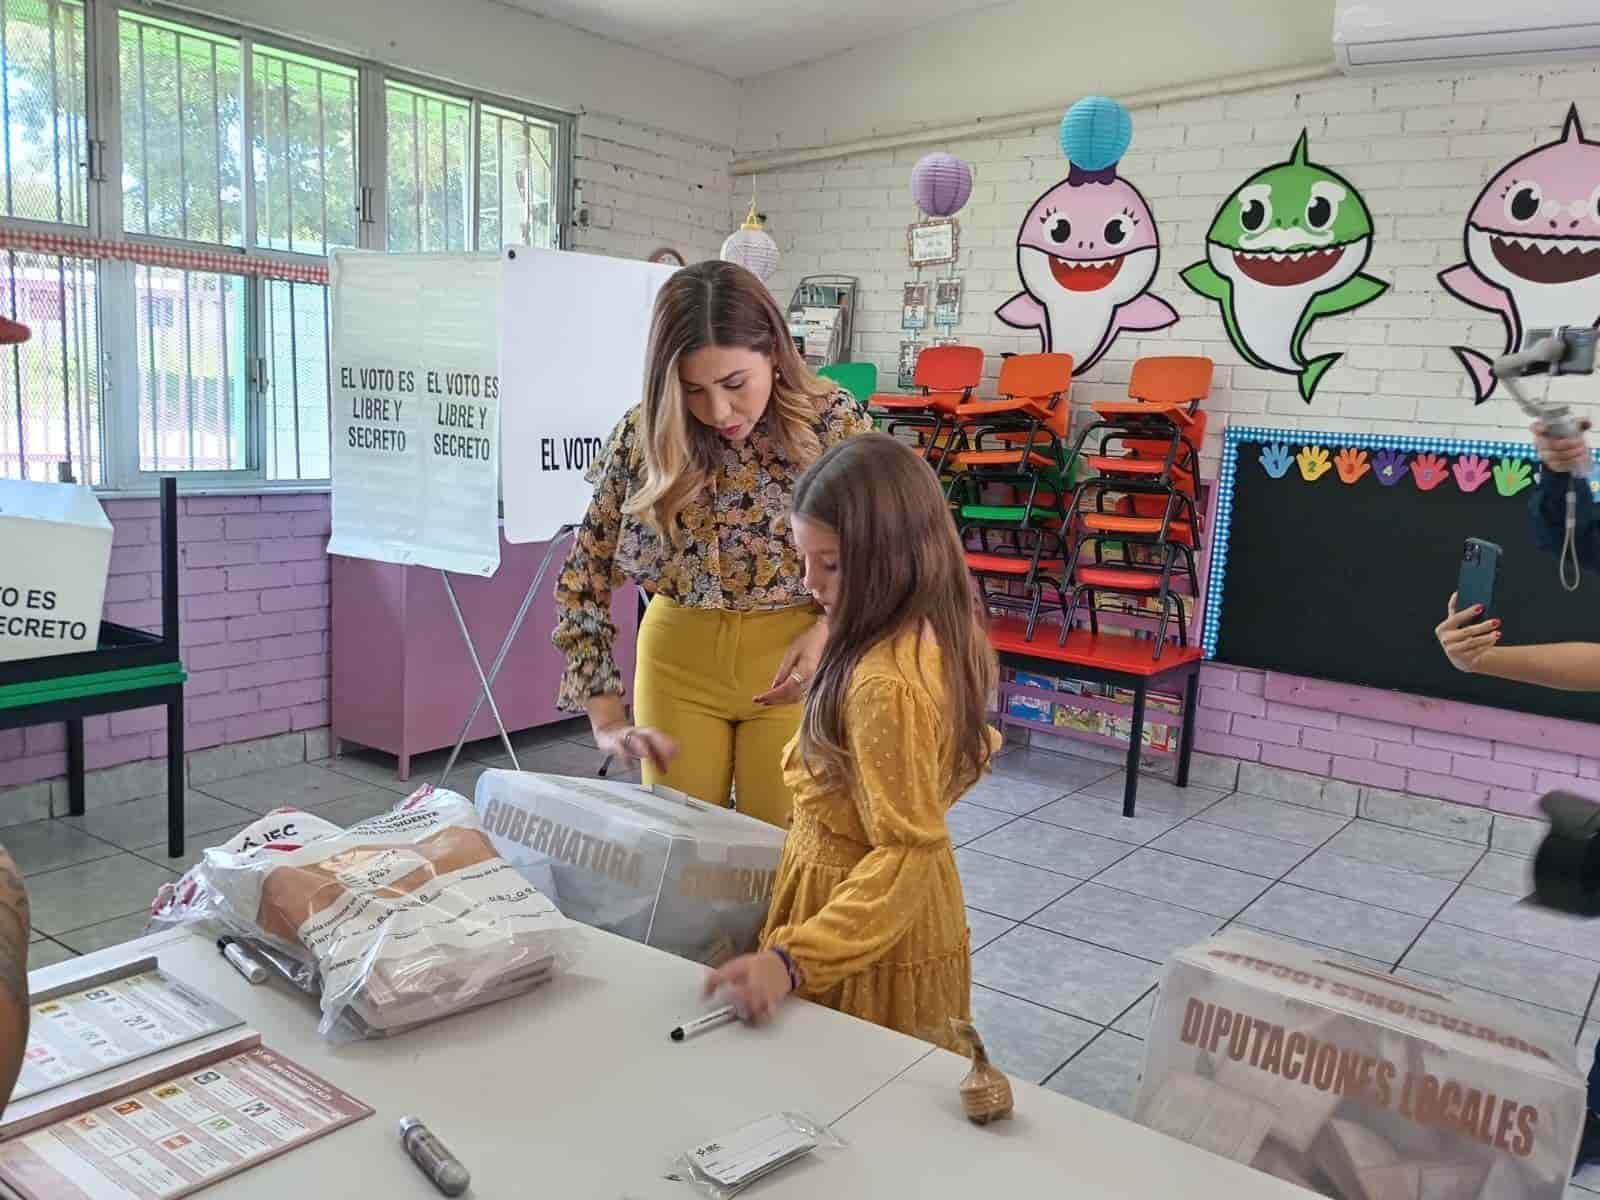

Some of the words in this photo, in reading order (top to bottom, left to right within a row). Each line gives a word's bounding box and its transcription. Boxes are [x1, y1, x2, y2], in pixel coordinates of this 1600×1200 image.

[341, 368, 356, 388] EL
[360, 368, 394, 391] VOTO
[399, 370, 415, 392] ES
[427, 372, 442, 394] EL
[446, 372, 480, 397] VOTO
[484, 376, 499, 399] ES
[353, 397, 389, 421] LIBRE
[394, 399, 402, 422] Y
[438, 402, 474, 428] LIBRE
[479, 407, 487, 430] Y
[348, 426, 406, 451] SECRETO
[434, 433, 490, 461] SECRETO
[541, 438, 560, 471] EL
[563, 437, 602, 470] VOTO
[1383, 465, 1393, 477] 4
[0, 586, 18, 607] O
[26, 589, 56, 610] ES
[264, 823, 298, 842] IEC
[483, 799, 641, 889] GUBERNATURA
[1181, 997, 1396, 1106] DIPUTACIONES
[1399, 1072, 1538, 1157] LOCALES
